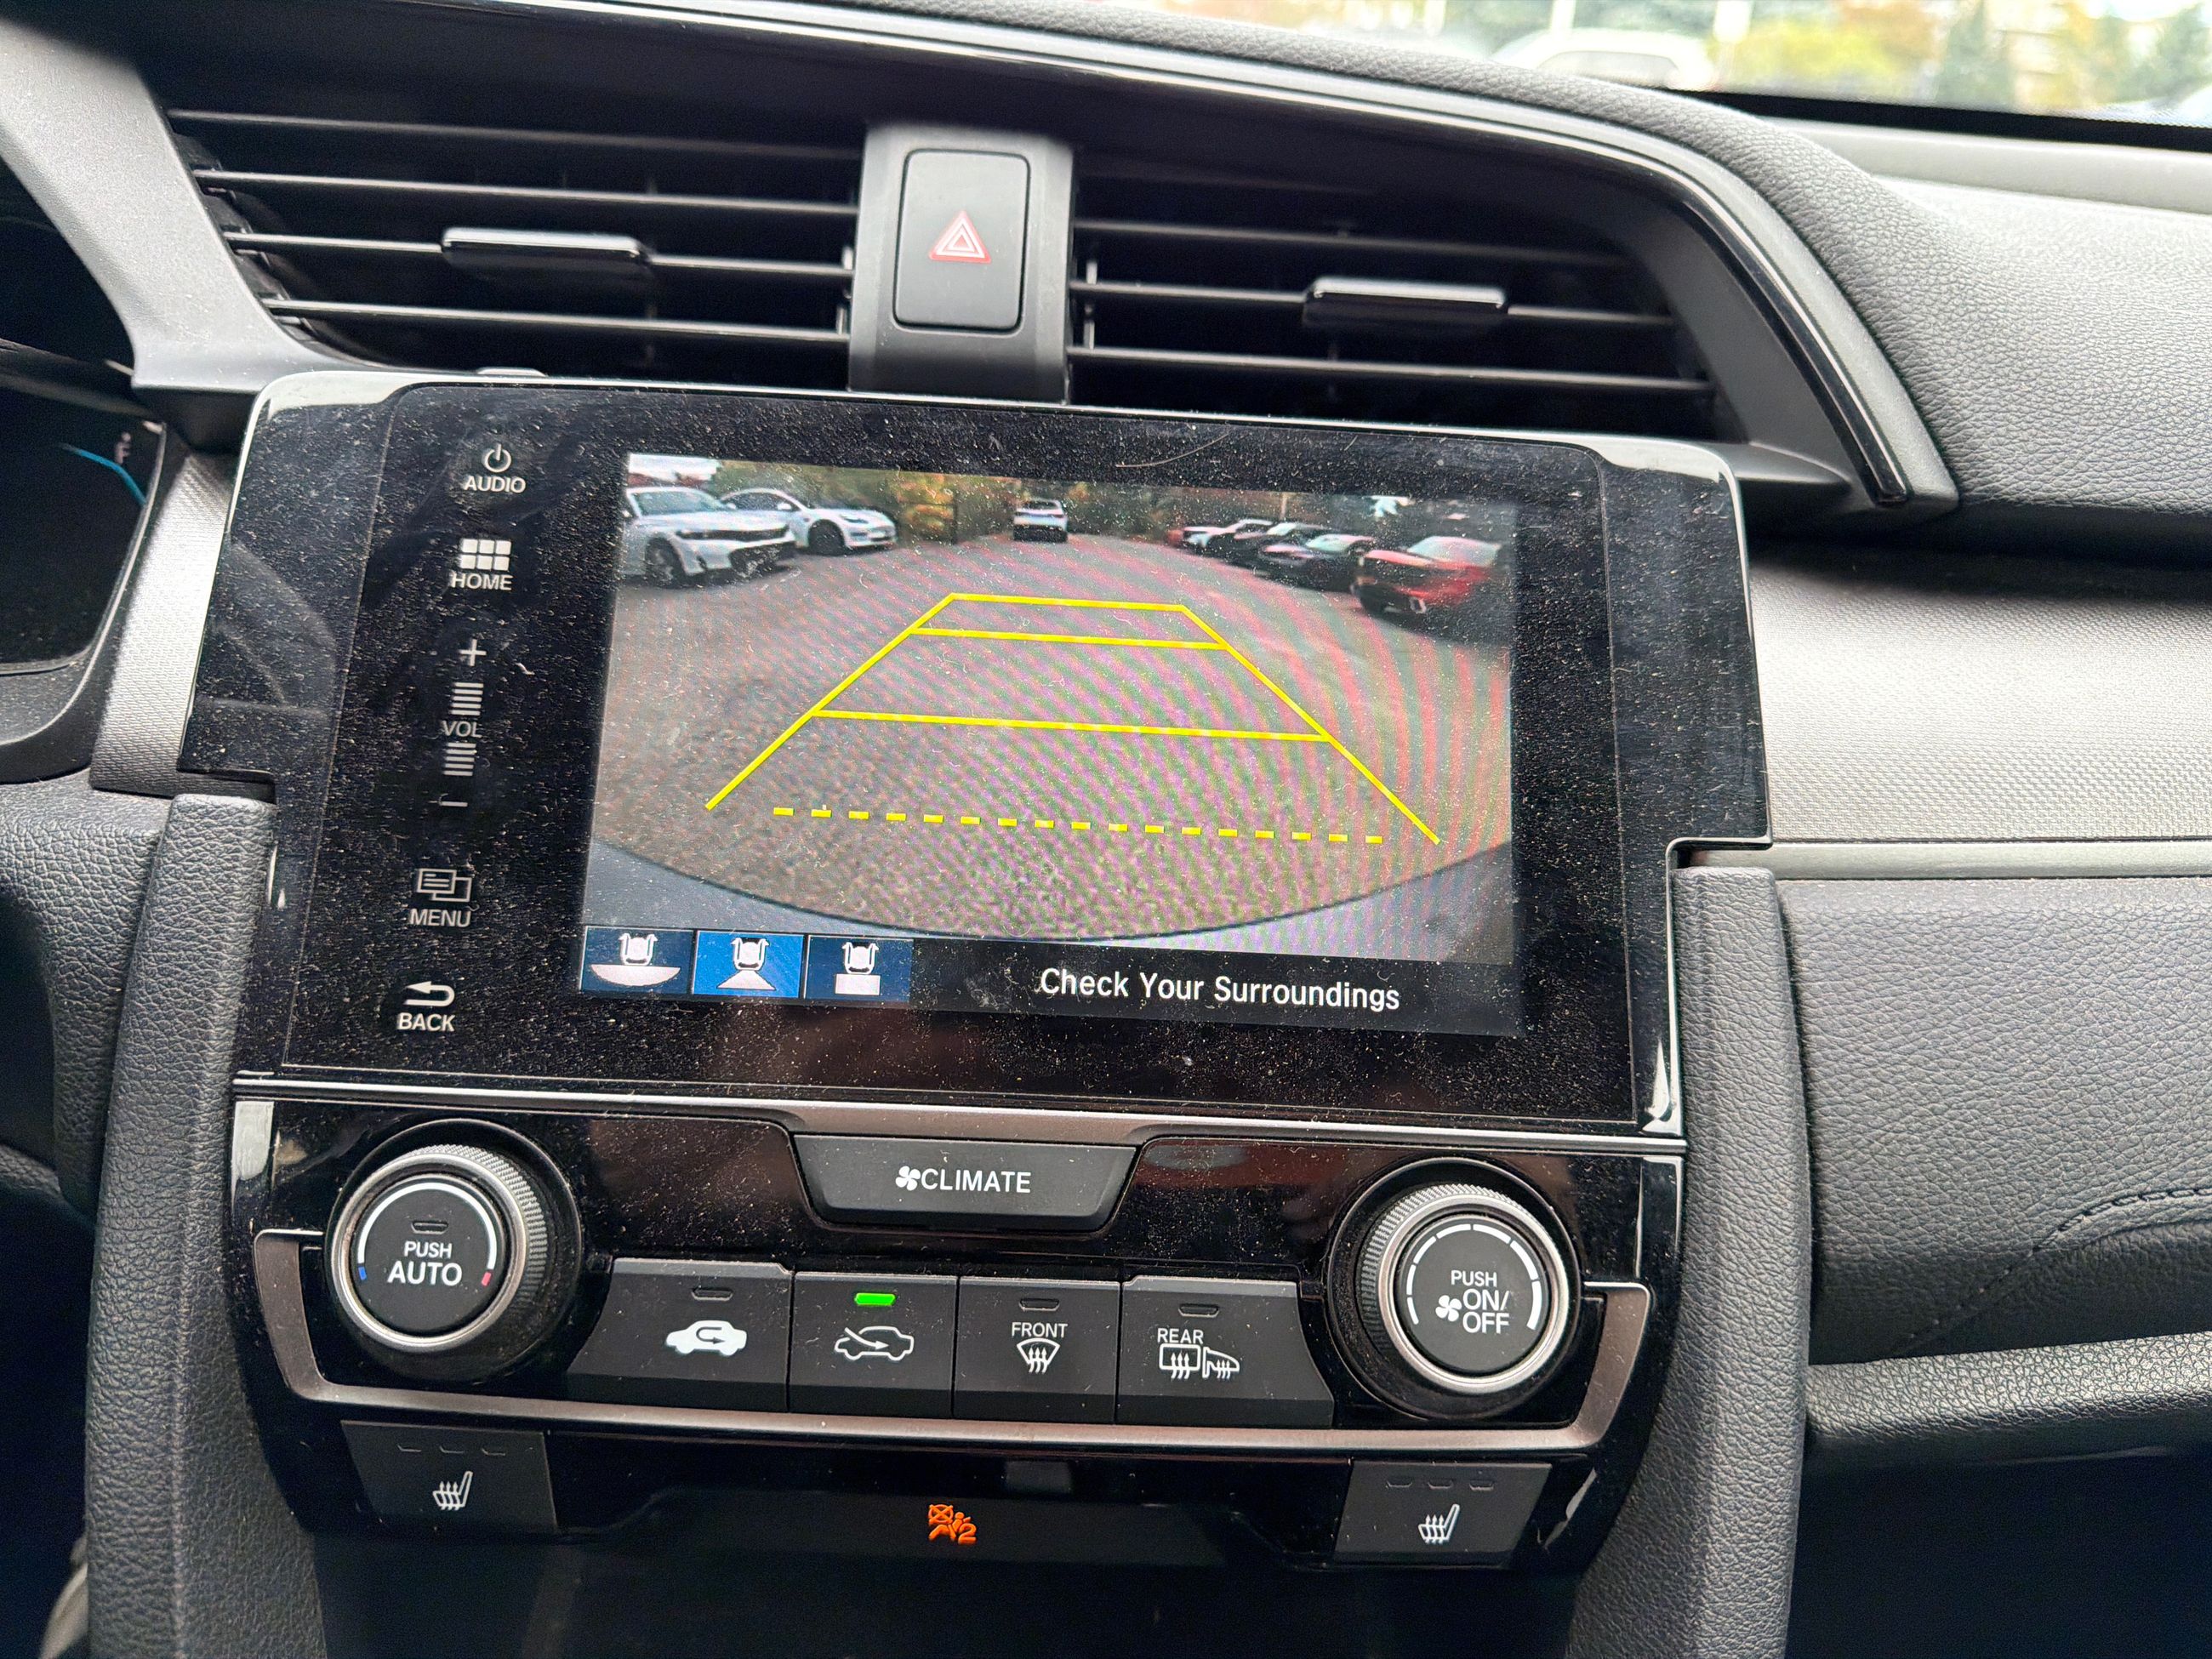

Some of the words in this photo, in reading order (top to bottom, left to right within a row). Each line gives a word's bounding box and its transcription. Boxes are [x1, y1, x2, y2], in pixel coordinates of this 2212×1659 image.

[463, 476, 527, 493] AUDIO
[450, 572, 513, 591] HOME
[442, 721, 483, 737] VOL
[409, 908, 472, 928] MENU
[1040, 967, 1129, 999] Check
[1138, 972, 1205, 1001] Your
[1213, 976, 1400, 1013] Surroundings
[396, 1012, 456, 1032] BACK
[921, 1168, 1032, 1194] CLIMATE
[403, 1240, 453, 1259] PUSH
[386, 1260, 463, 1286] AUTO
[1451, 1269, 1497, 1287] PUSH
[1462, 1288, 1510, 1311] ON/
[1011, 1321, 1069, 1339] FRONT
[1462, 1311, 1510, 1334] OFF
[1156, 1327, 1205, 1345] REAR
